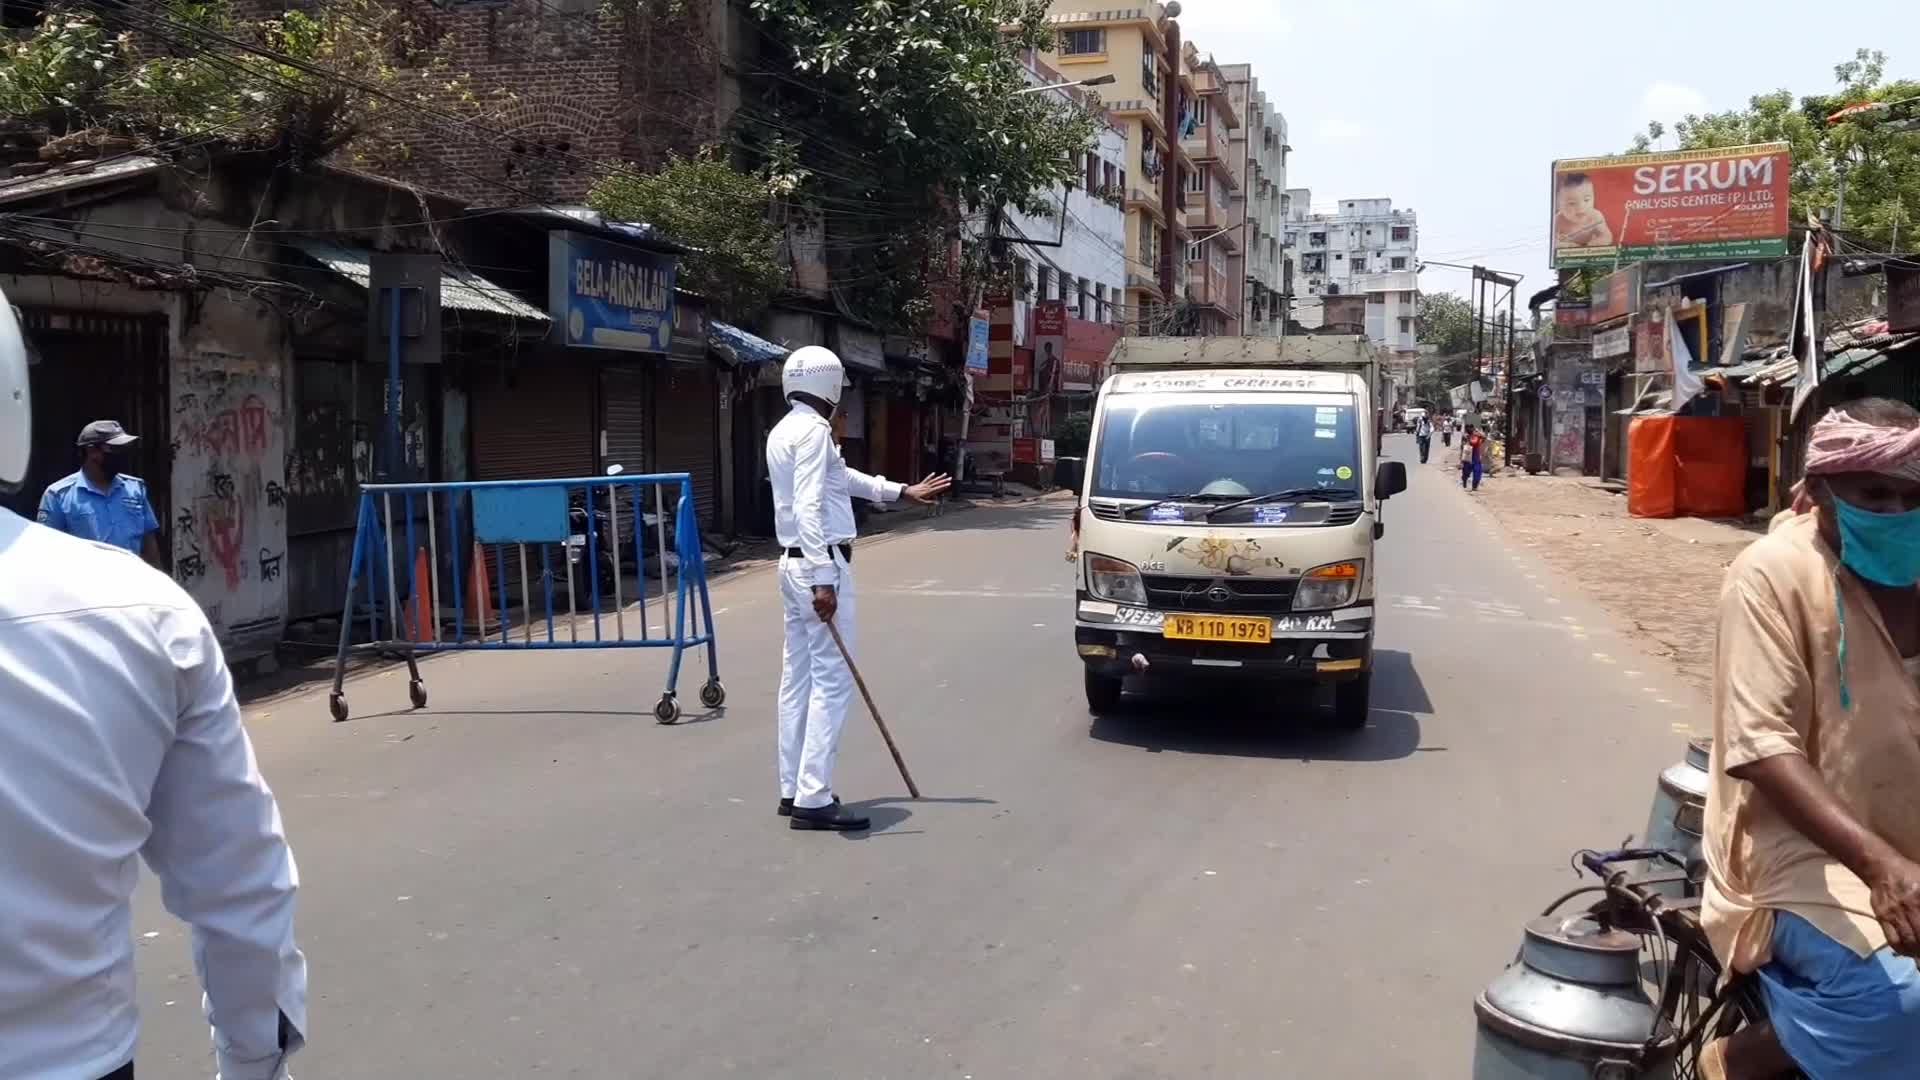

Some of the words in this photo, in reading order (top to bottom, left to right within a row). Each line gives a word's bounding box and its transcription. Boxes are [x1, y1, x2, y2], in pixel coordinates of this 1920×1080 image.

[1681, 150, 1718, 160] TESTING
[1633, 157, 1773, 195] SERUM
[1625, 196, 1679, 210] ANALYSIS
[1681, 193, 1726, 207] CENTRE
[1734, 202, 1775, 211] KOLKATA
[1141, 560, 1165, 571] ACE
[1113, 607, 1165, 625] SPEED
[1306, 615, 1337, 631] KM.
[1175, 618, 1194, 634] WB
[1199, 620, 1225, 636] 11D
[1231, 622, 1266, 638] 1979
